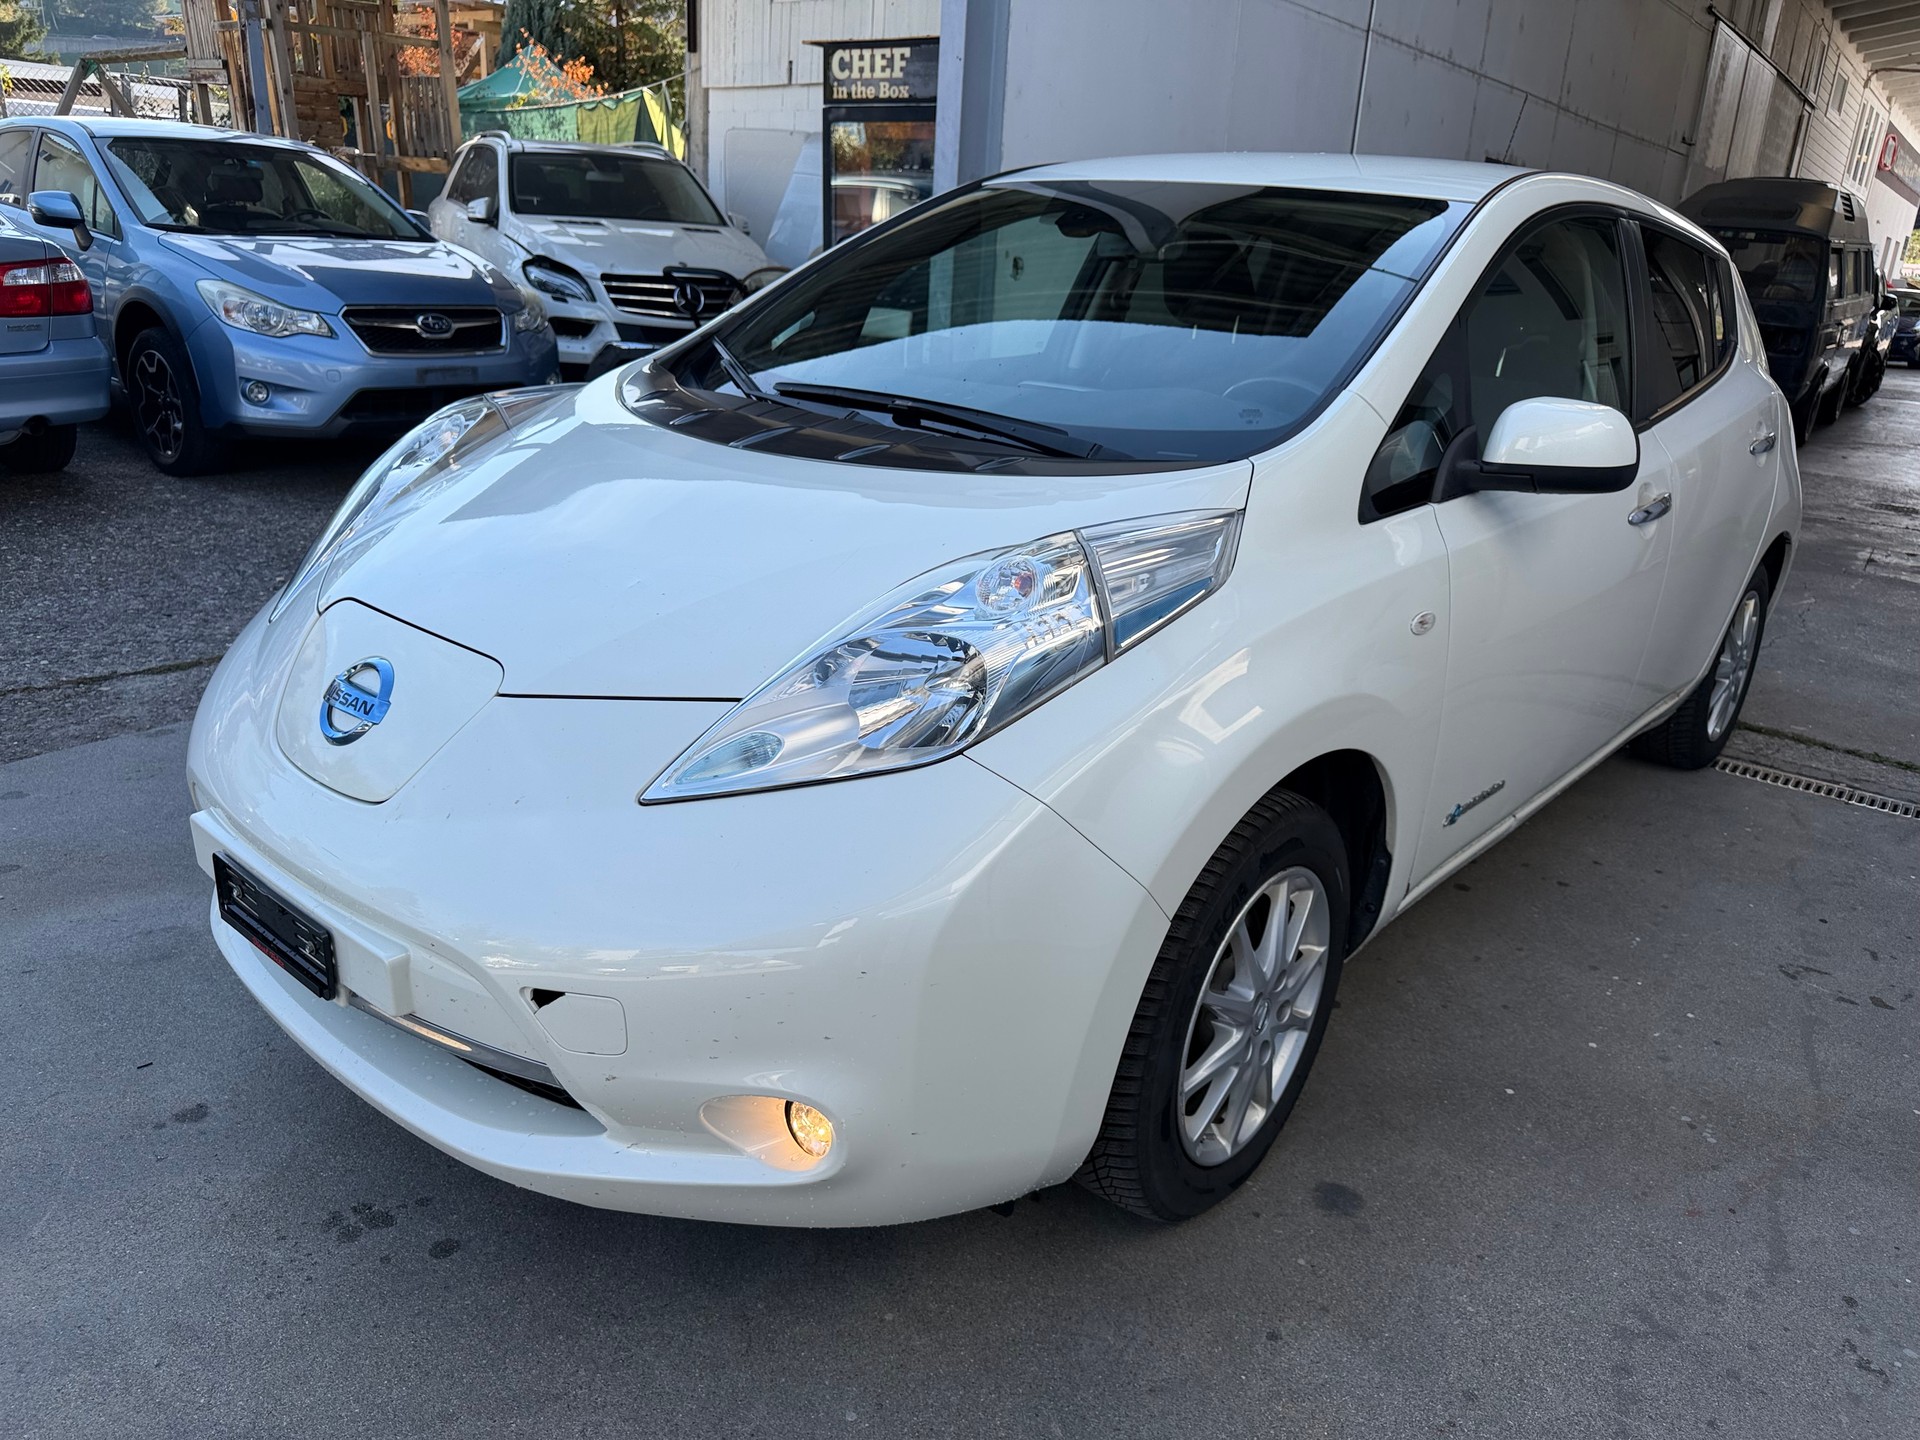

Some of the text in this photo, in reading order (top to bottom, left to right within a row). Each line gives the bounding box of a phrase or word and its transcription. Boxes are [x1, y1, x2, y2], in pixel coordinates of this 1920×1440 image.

[832, 47, 911, 80] CHEF
[833, 81, 910, 99] in the Box
